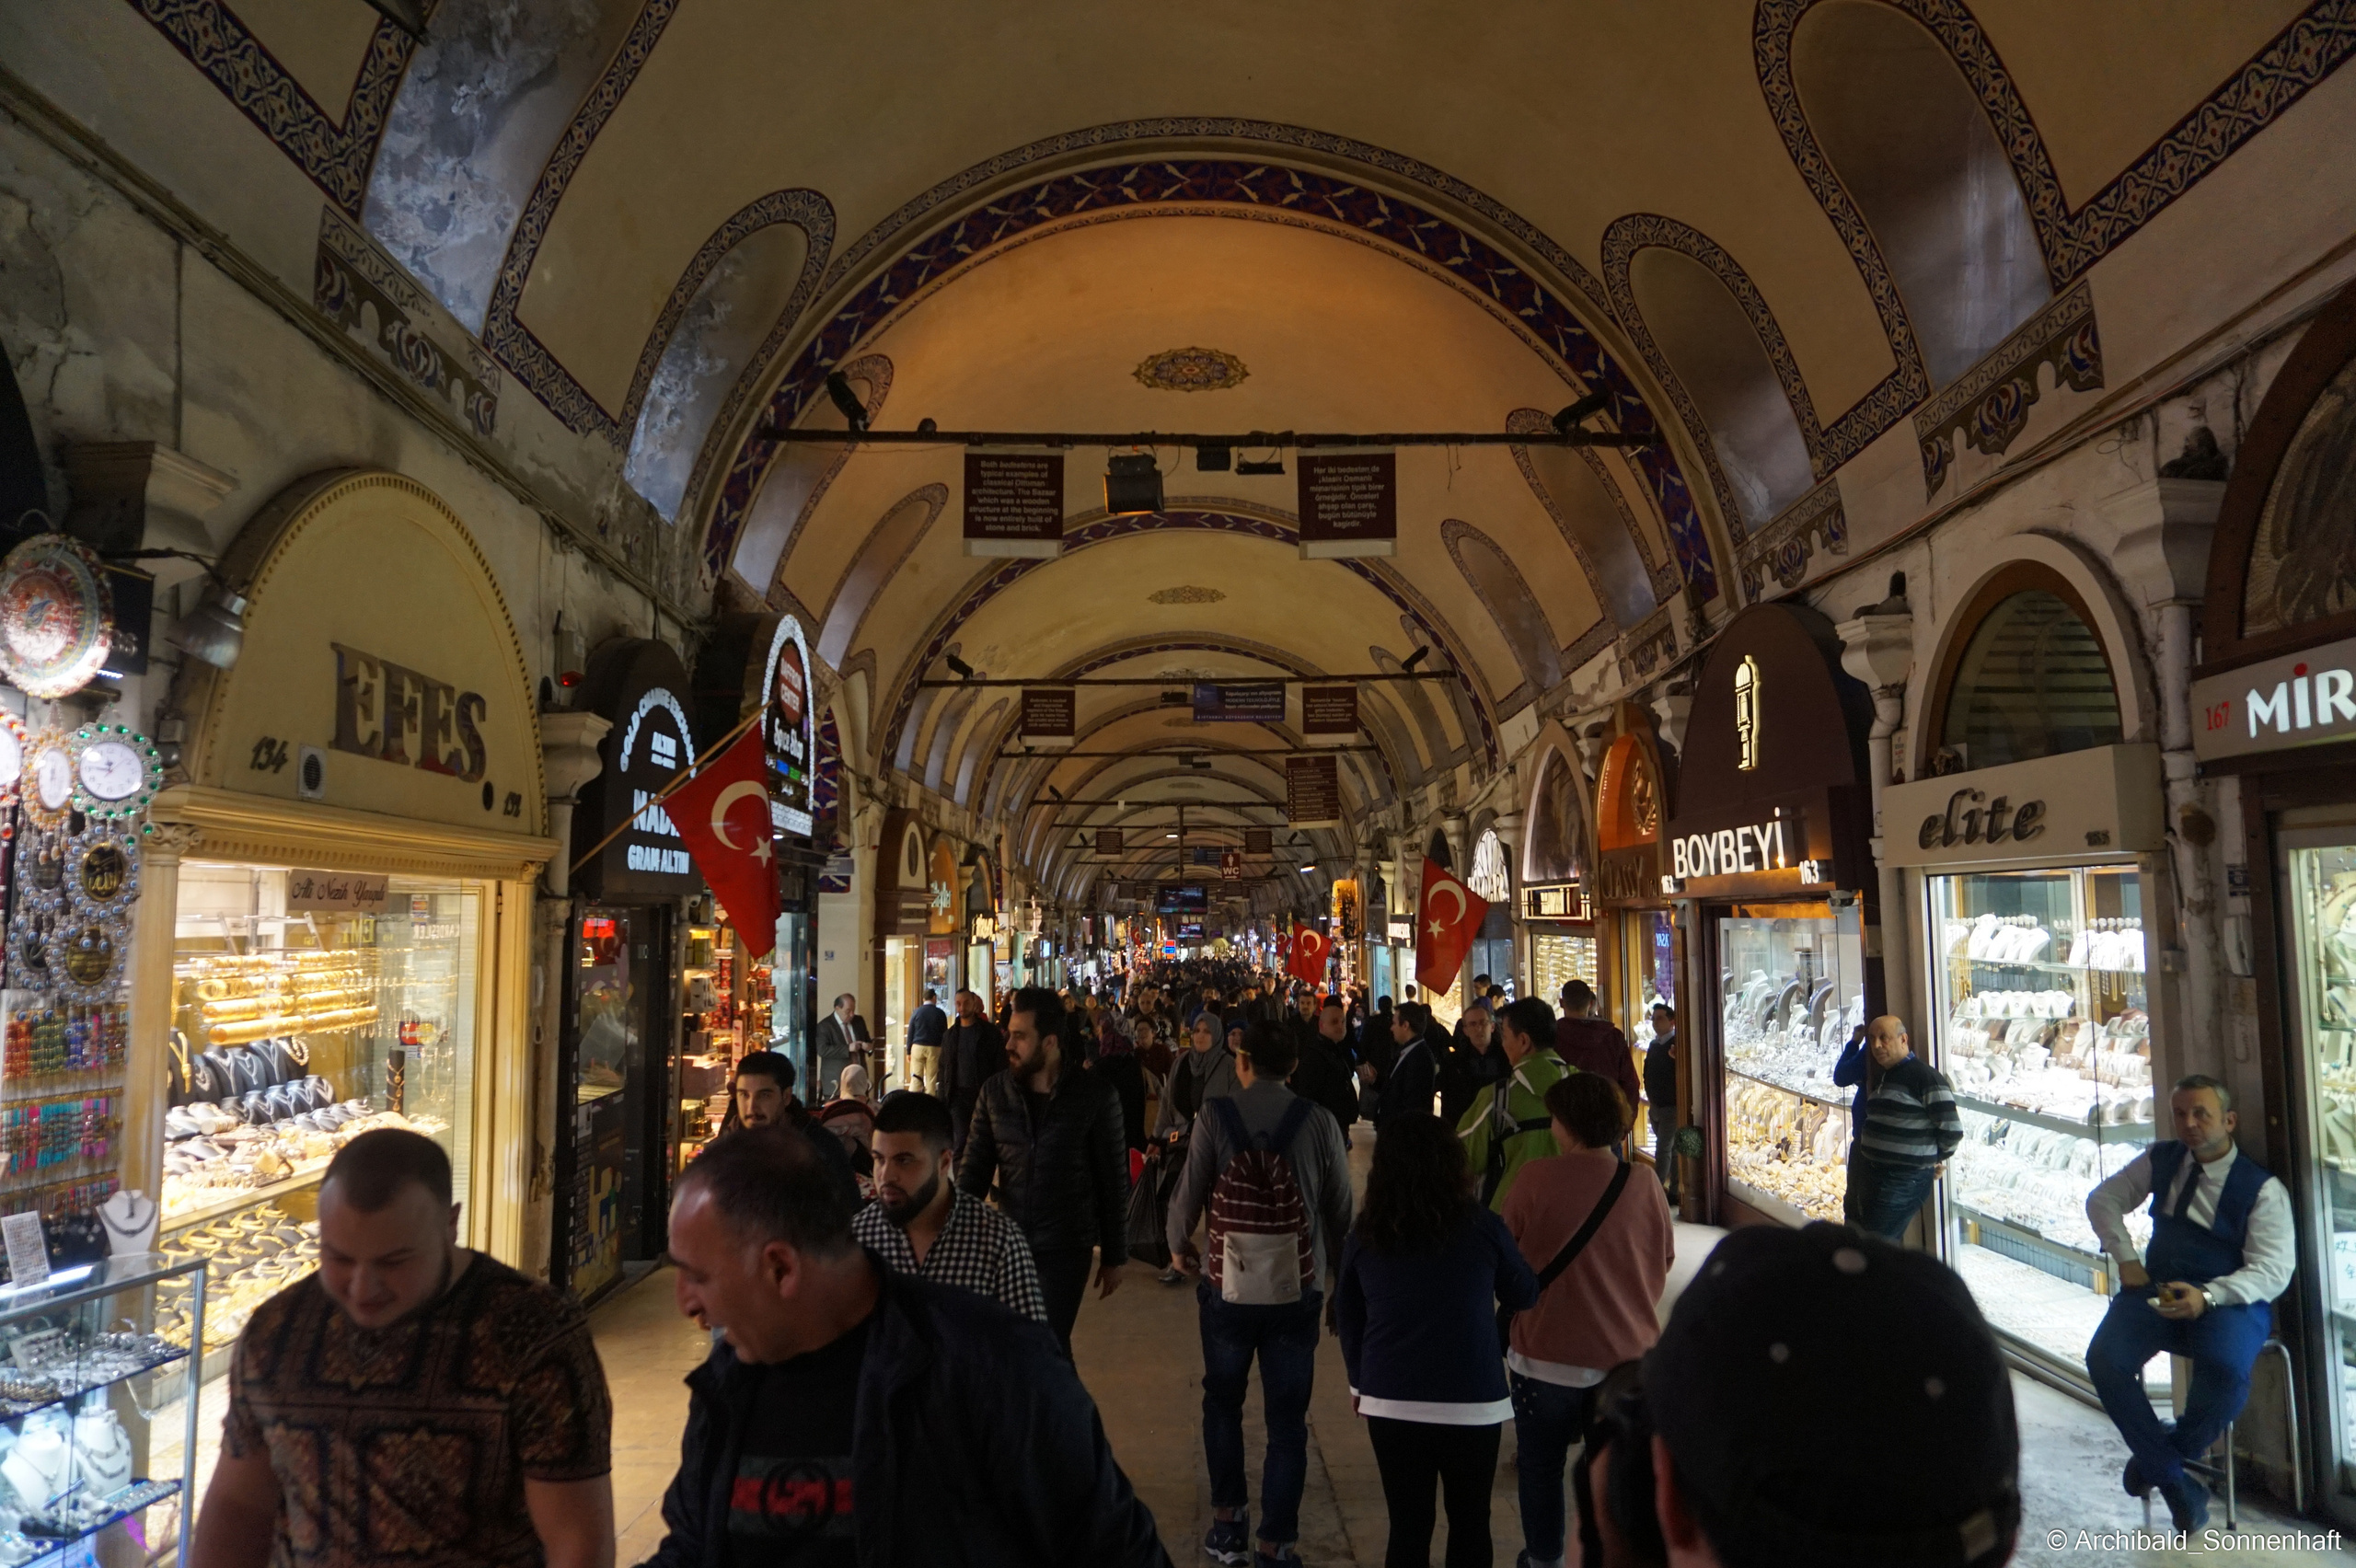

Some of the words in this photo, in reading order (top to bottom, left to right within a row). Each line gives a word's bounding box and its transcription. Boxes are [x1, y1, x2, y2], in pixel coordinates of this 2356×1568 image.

[981, 470, 1003, 478] typical
[999, 515, 1026, 524] entirely
[1023, 507, 1058, 515] beginning
[329, 641, 486, 783] EFES
[2246, 662, 2356, 739] MİR
[2206, 701, 2230, 731] 167
[249, 736, 289, 774] 134
[633, 789, 680, 837] NAD
[1919, 788, 2046, 849] elite
[1672, 806, 1785, 880] BOYBEYİ
[628, 844, 660, 871] GRAM
[660, 849, 689, 874] ALTIN
[1223, 867, 1240, 875] WC
[1798, 859, 1819, 885] 163
[1661, 875, 1674, 894] 163
